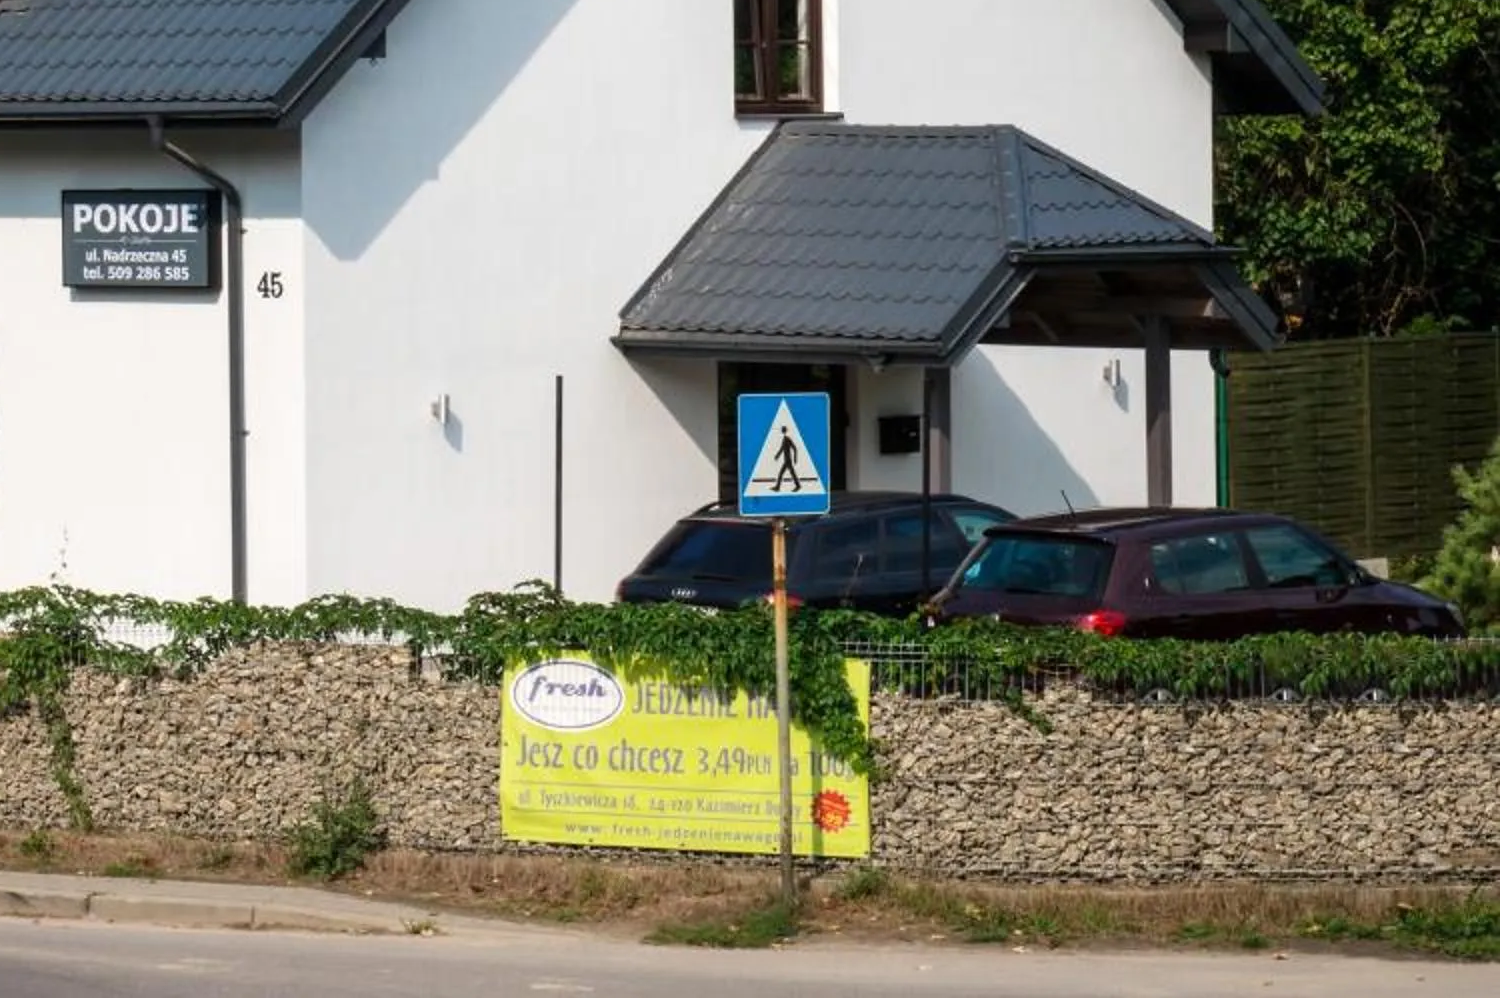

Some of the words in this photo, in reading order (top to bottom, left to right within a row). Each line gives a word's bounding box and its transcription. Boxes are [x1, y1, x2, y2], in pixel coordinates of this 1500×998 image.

[73, 203, 199, 234] POKOJE
[85, 248, 101, 263] ul.
[103, 248, 169, 263] Nadrzeczna
[171, 249, 187, 263] 45
[83, 265, 105, 280] tel.
[107, 265, 133, 280] 509
[135, 266, 161, 280] 286
[164, 266, 190, 281] 585
[257, 271, 284, 299] 45
[527, 675, 606, 702] fresh
[516, 734, 565, 769] Jesz
[573, 742, 599, 771] co
[608, 737, 685, 774] chcesz
